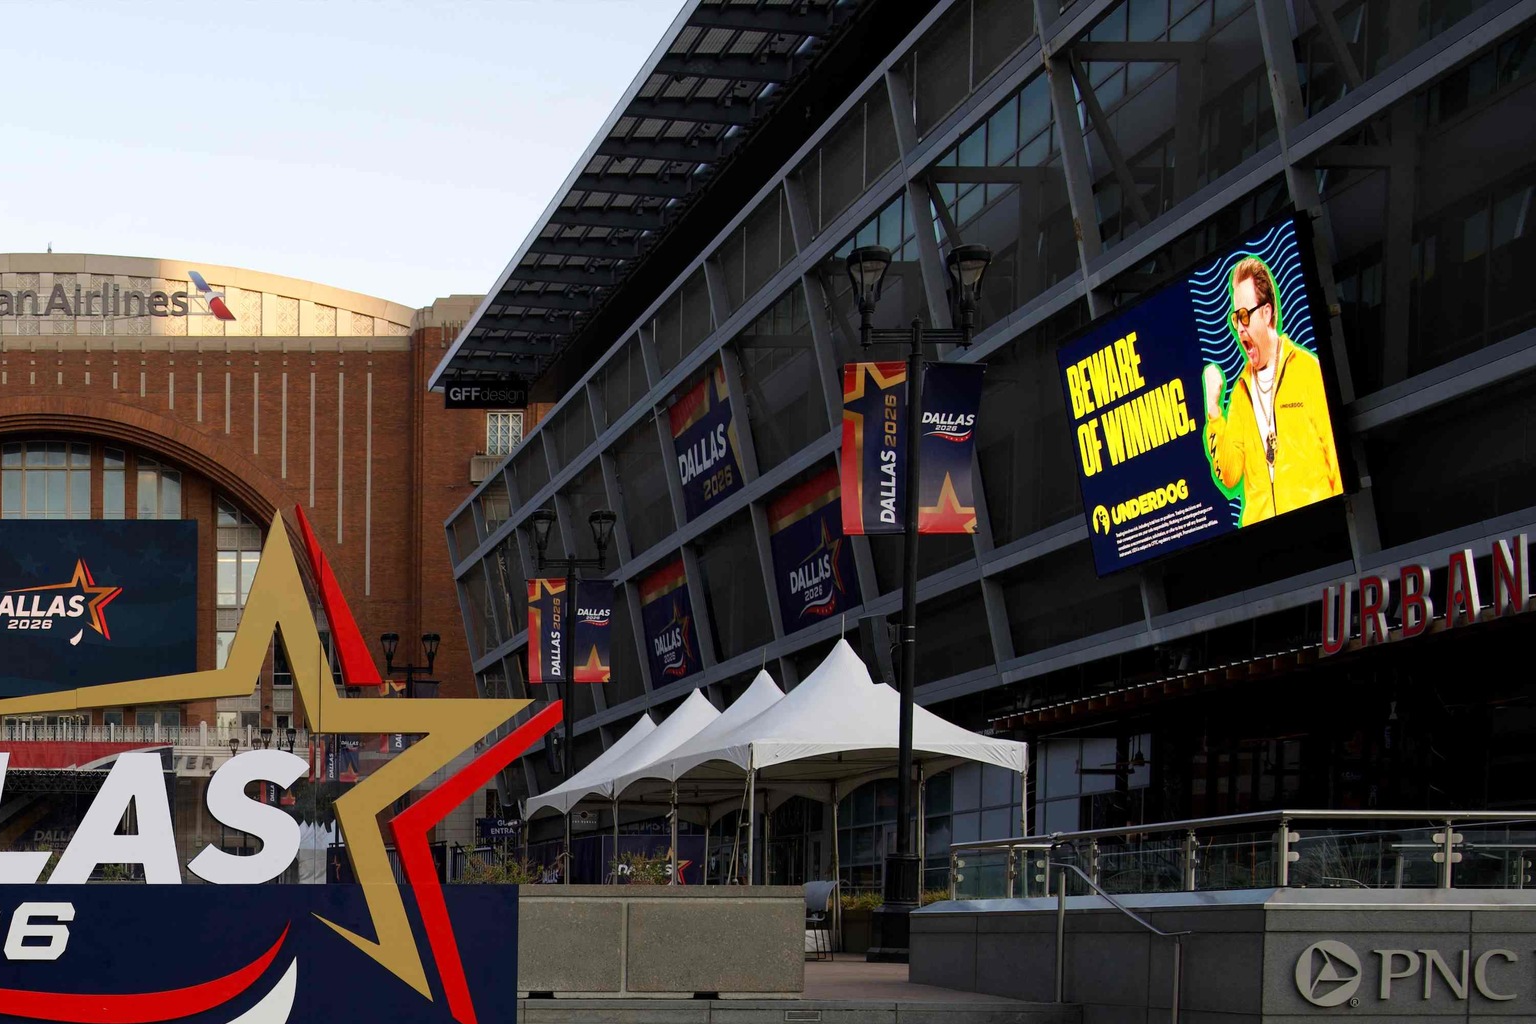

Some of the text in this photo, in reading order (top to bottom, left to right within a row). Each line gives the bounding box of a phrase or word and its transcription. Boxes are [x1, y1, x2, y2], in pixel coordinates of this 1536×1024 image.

[44, 282, 189, 317] Airlines
[1066, 331, 1145, 420] BEWARE
[921, 411, 975, 426] DALLAS
[1077, 378, 1197, 477] OF WINNING.
[678, 422, 727, 486] DALLAS
[880, 394, 897, 524] DALLAS 2026
[703, 464, 733, 501] 2026
[1111, 479, 1189, 526] UNDERDOG
[790, 553, 831, 594] DALLAS
[804, 582, 823, 602] 2026
[1322, 533, 1529, 655] URBAN
[7, 619, 52, 630] 2026
[577, 608, 611, 617] DALLAS
[551, 598, 561, 676] DALLAS 2026
[654, 627, 682, 656] DALLAS
[34, 830, 75, 841] DALLA
[1371, 949, 1518, 1001] PNC
